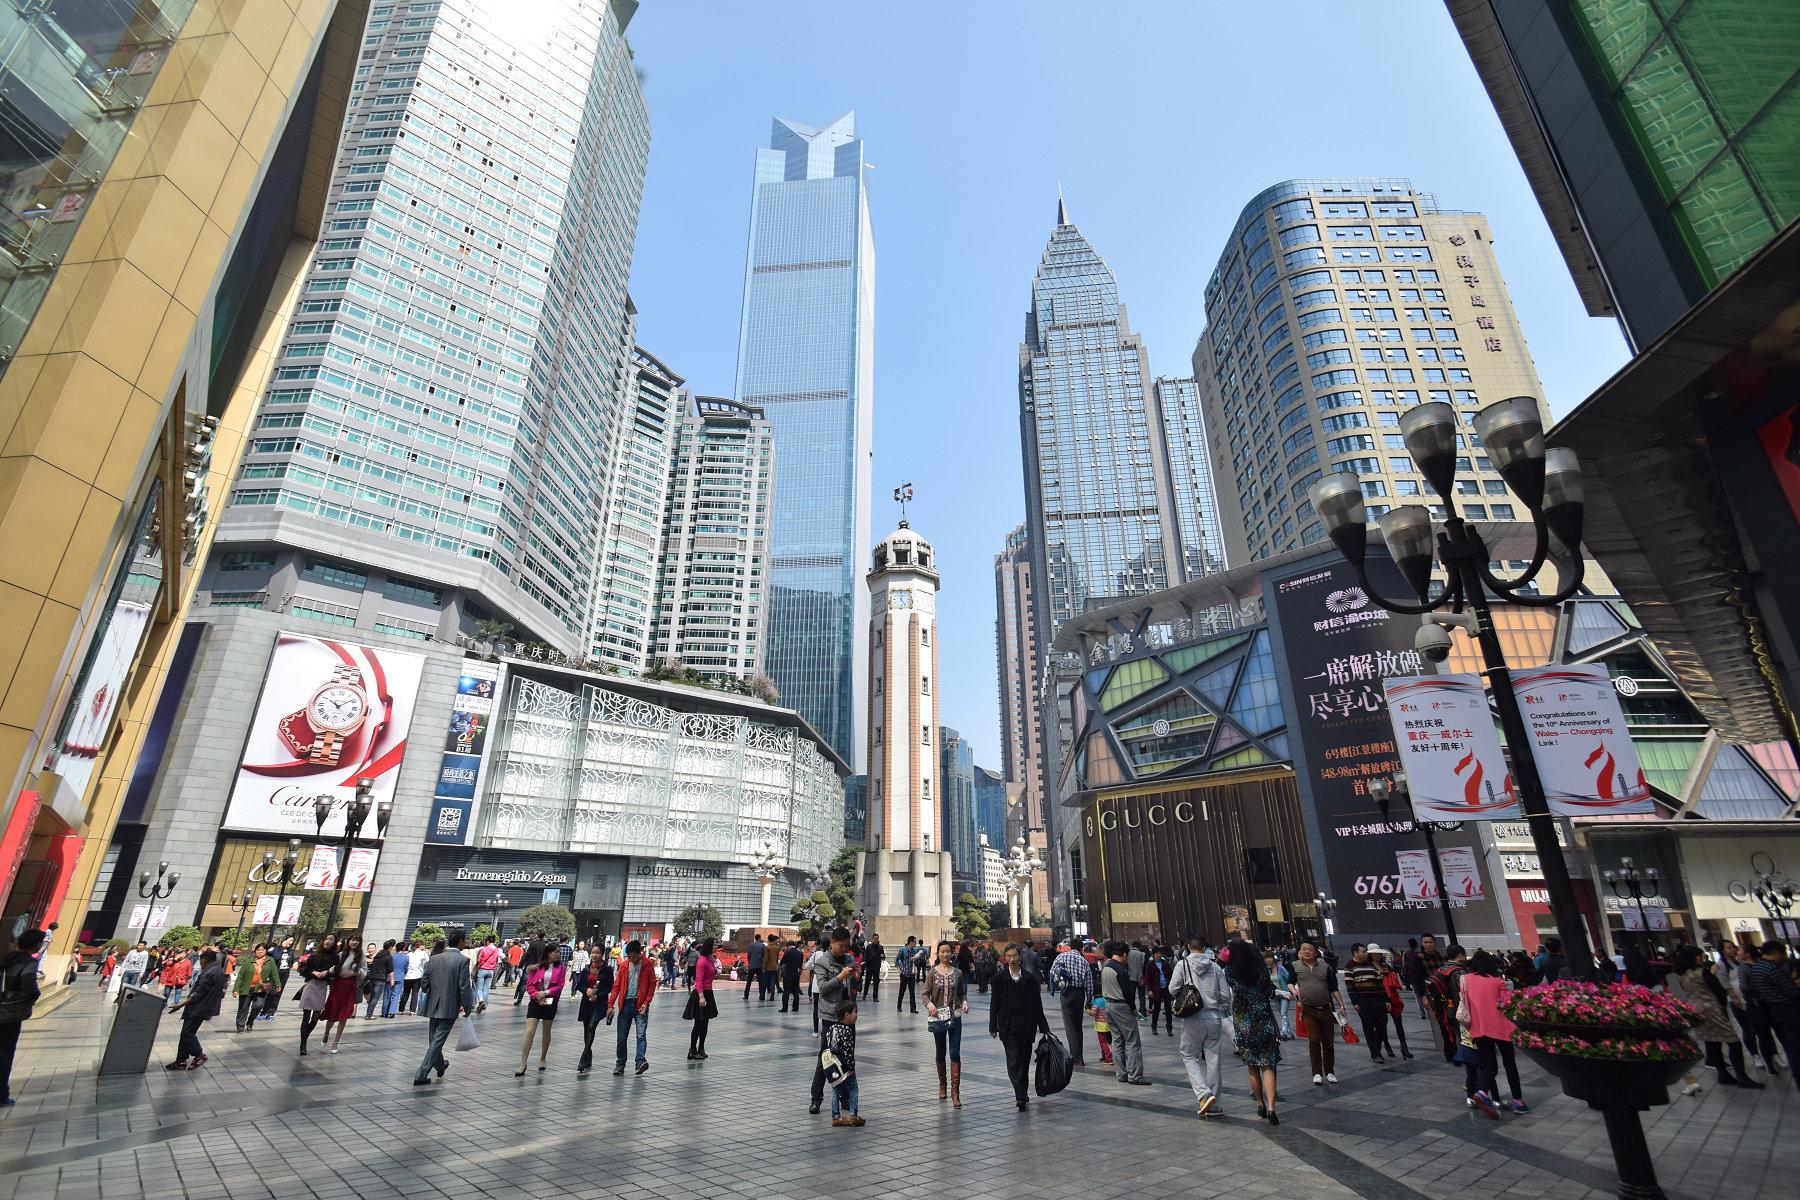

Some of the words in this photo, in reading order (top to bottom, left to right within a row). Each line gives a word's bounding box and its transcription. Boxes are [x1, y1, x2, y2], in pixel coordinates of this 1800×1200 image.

[1303, 649, 1424, 687] 一席解放碑
[1309, 685, 1389, 720] 尽享心
[1530, 710, 1586, 720] Congratulations
[1404, 718, 1445, 729] 热烈庆祝
[1559, 718, 1601, 728] Anniversary
[1569, 728, 1614, 736] Chongqing
[269, 785, 352, 810] Carer
[1101, 800, 1209, 831] GUCCI
[455, 867, 532, 884] Ermenegildo
[532, 870, 567, 886] Zegna
[637, 865, 670, 877] LOUIS
[675, 867, 721, 878] VUITTON
[1520, 889, 1551, 903] MUJI
